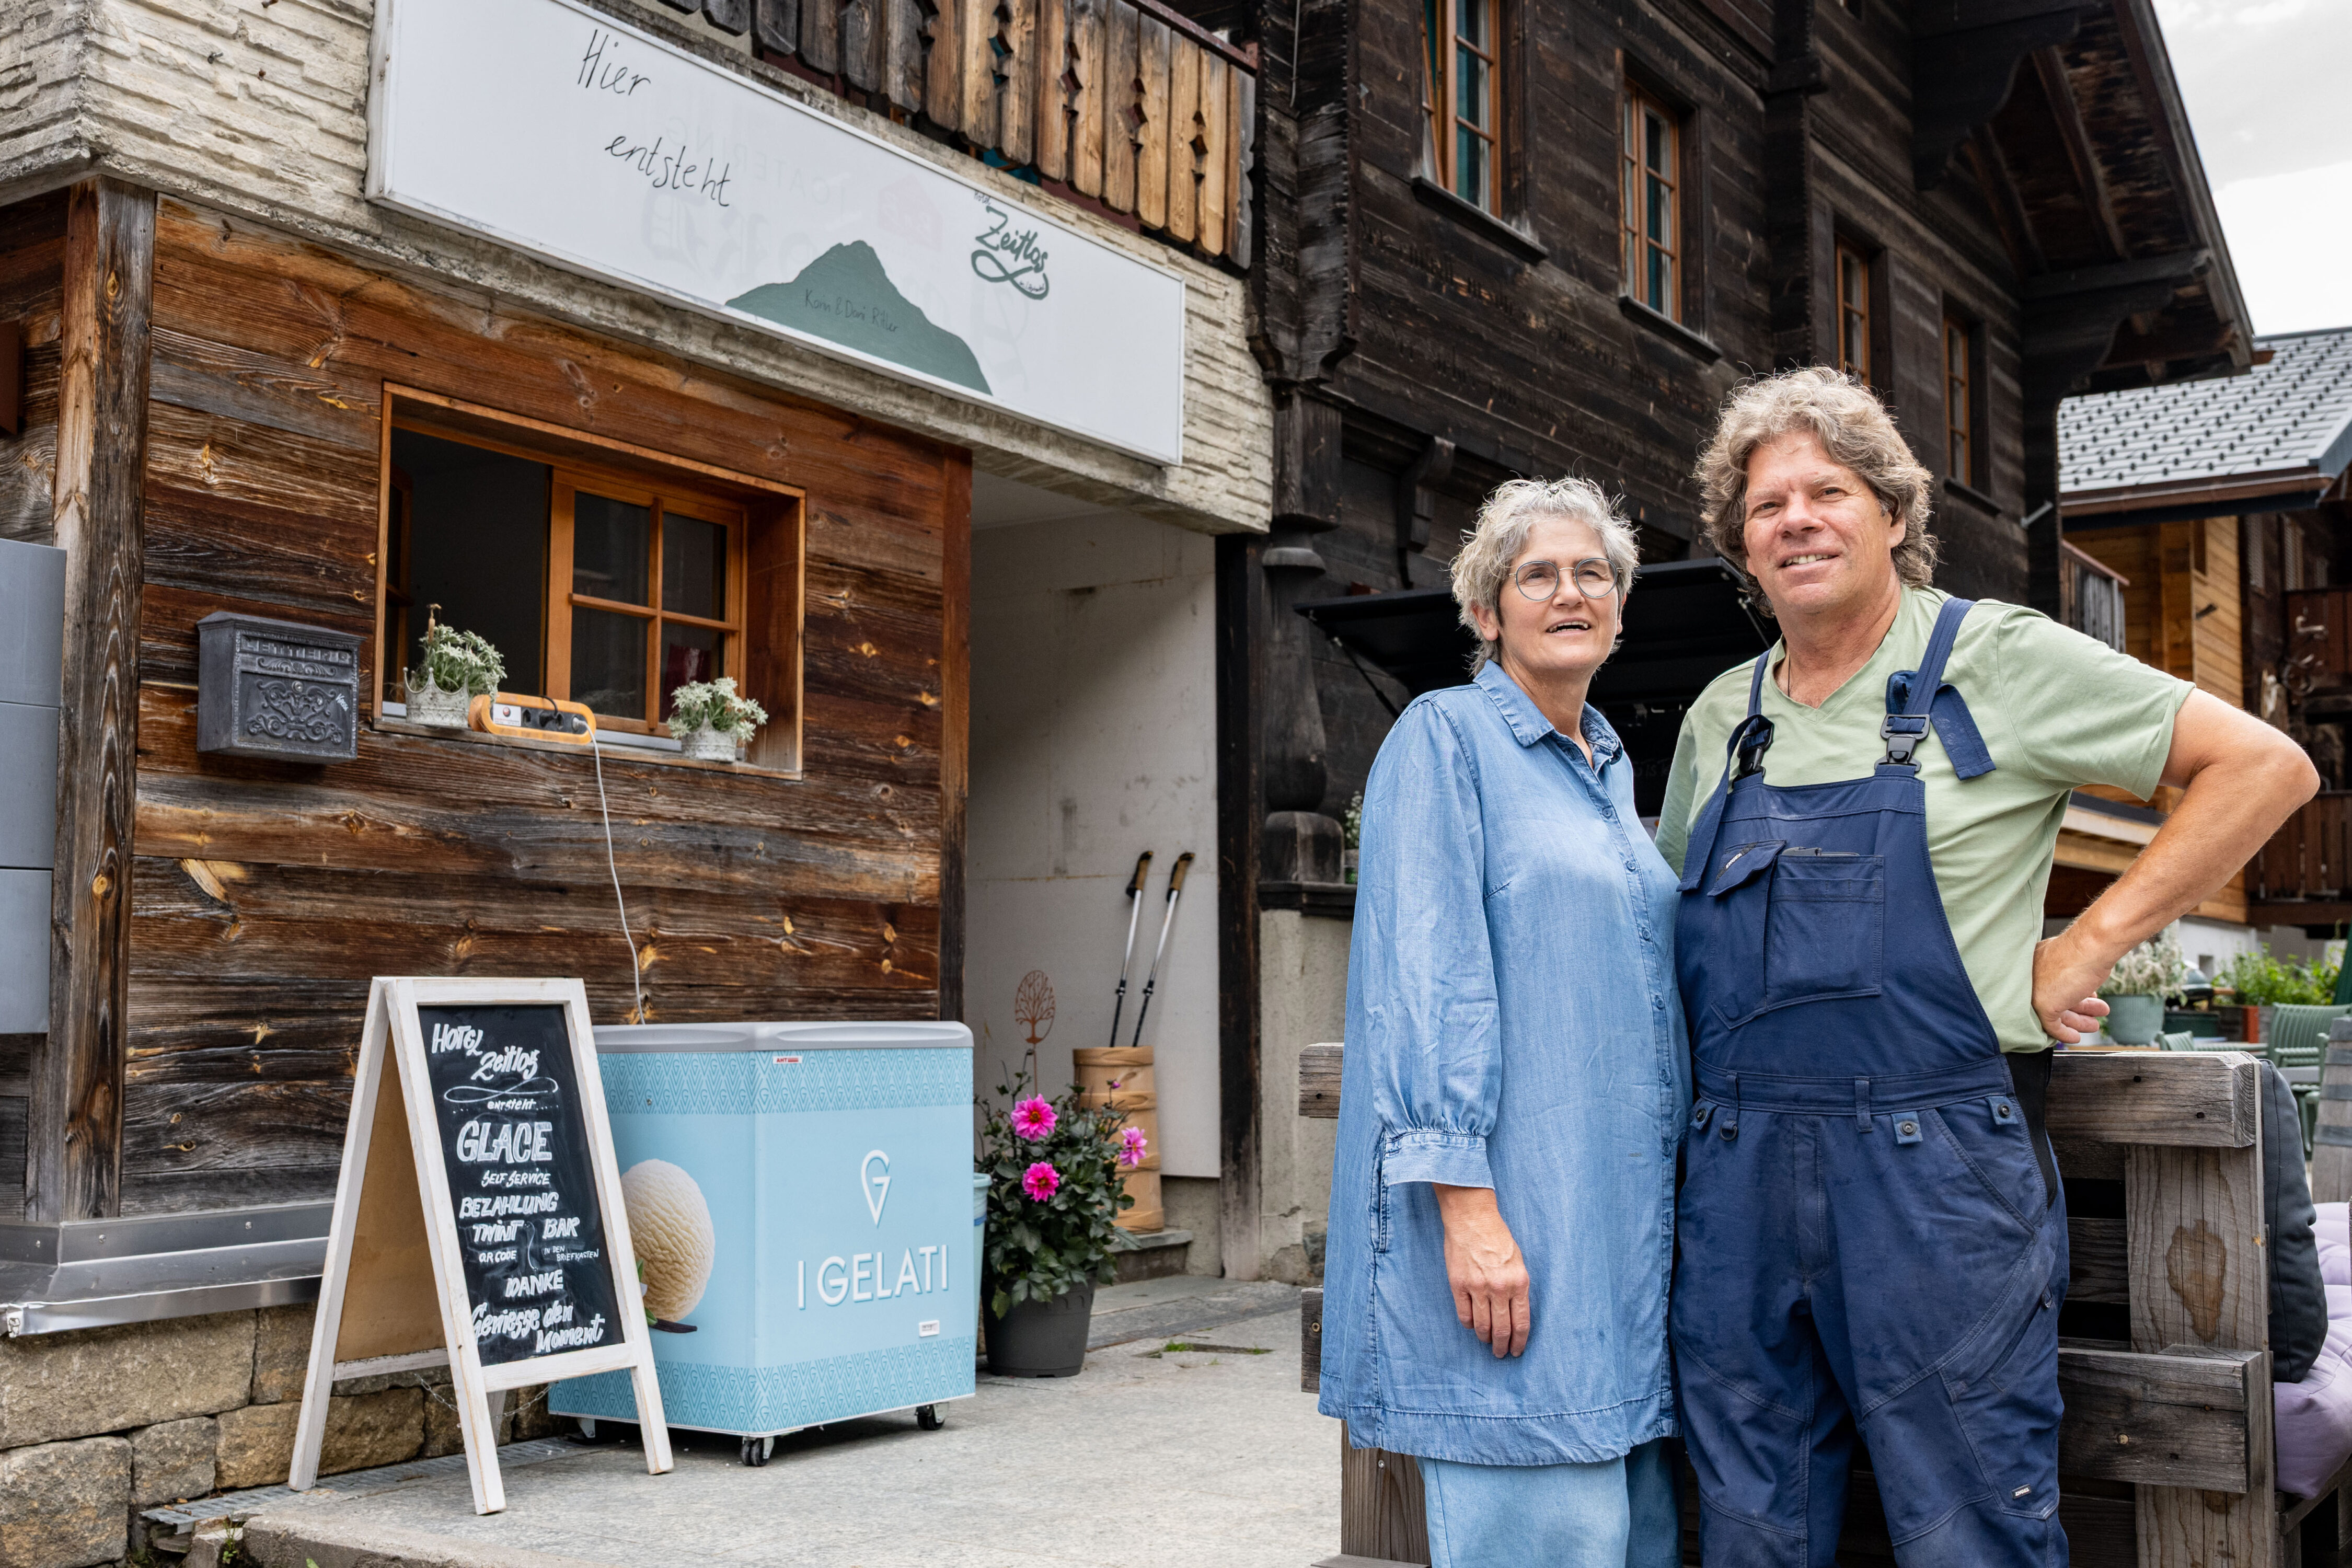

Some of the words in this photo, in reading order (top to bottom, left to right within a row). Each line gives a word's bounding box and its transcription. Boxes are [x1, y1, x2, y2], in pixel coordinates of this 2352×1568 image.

[578, 29, 651, 95] Hier
[605, 135, 730, 207] entsteht
[975, 205, 1048, 273] Zeitlos
[456, 1121, 552, 1163] GLACE
[481, 1170, 508, 1187] SELF
[459, 1192, 559, 1218] BEZAHLUNG
[543, 1217, 580, 1239] BAR
[495, 1250, 517, 1262] CODE
[505, 1269, 563, 1297] DANKE
[798, 1260, 805, 1310] I
[817, 1244, 949, 1307] GELATI
[543, 1300, 573, 1328] den
[536, 1313, 605, 1353] Moment
